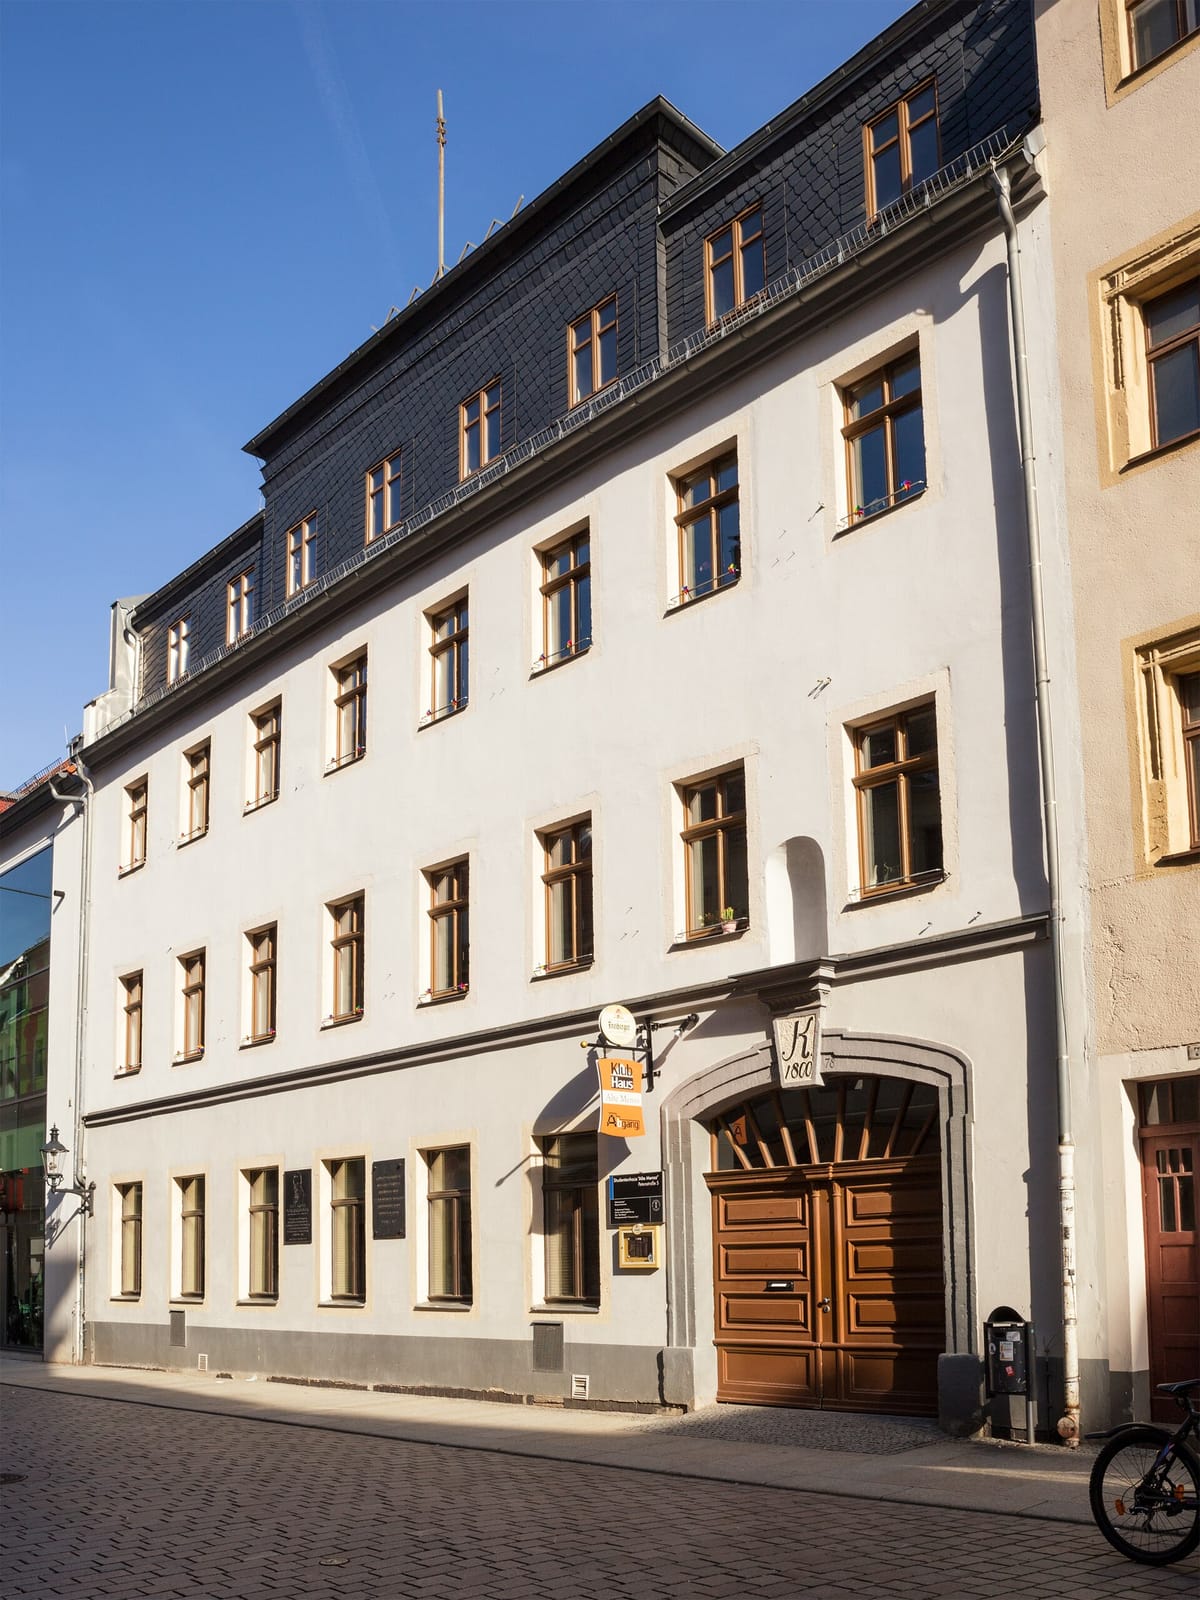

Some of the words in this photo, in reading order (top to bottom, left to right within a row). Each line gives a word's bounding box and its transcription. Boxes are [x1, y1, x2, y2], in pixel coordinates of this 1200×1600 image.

[611, 1062, 633, 1077] Klub
[785, 1061, 813, 1079] 1800
[611, 1077, 634, 1090] Haus
[607, 1112, 640, 1131] Abgang
